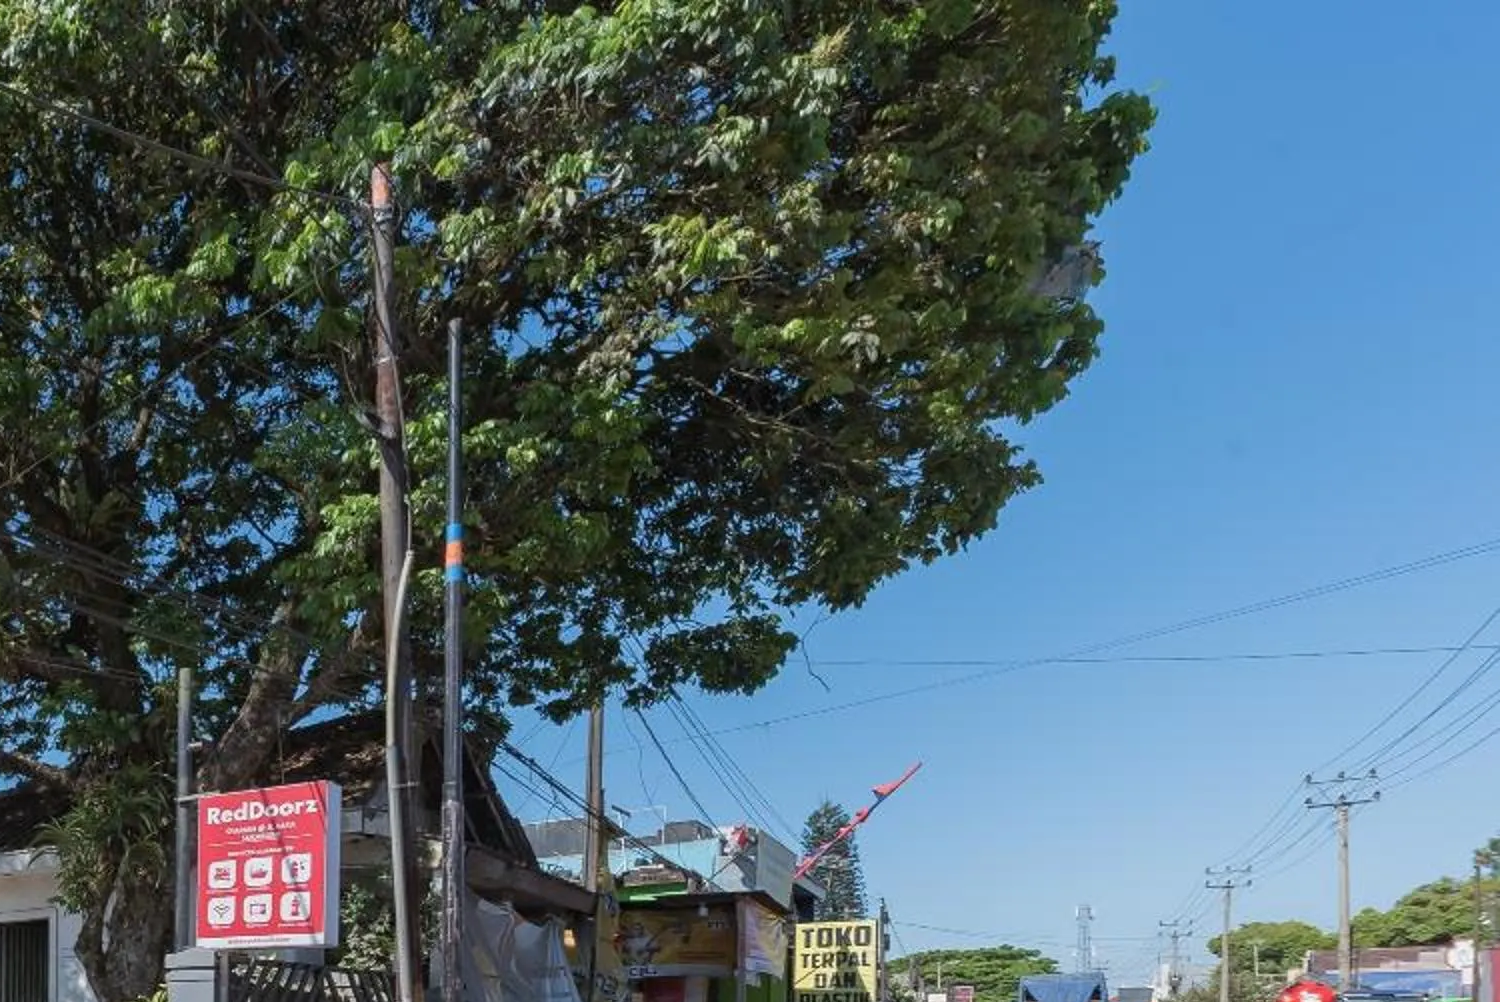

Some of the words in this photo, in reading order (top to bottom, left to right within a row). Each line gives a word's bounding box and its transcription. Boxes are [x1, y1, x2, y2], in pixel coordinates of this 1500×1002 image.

[206, 799, 318, 825] RedDoorz
[801, 925, 871, 948] TOKO
[800, 951, 871, 968] TERPAL
[815, 971, 857, 989] DAN
